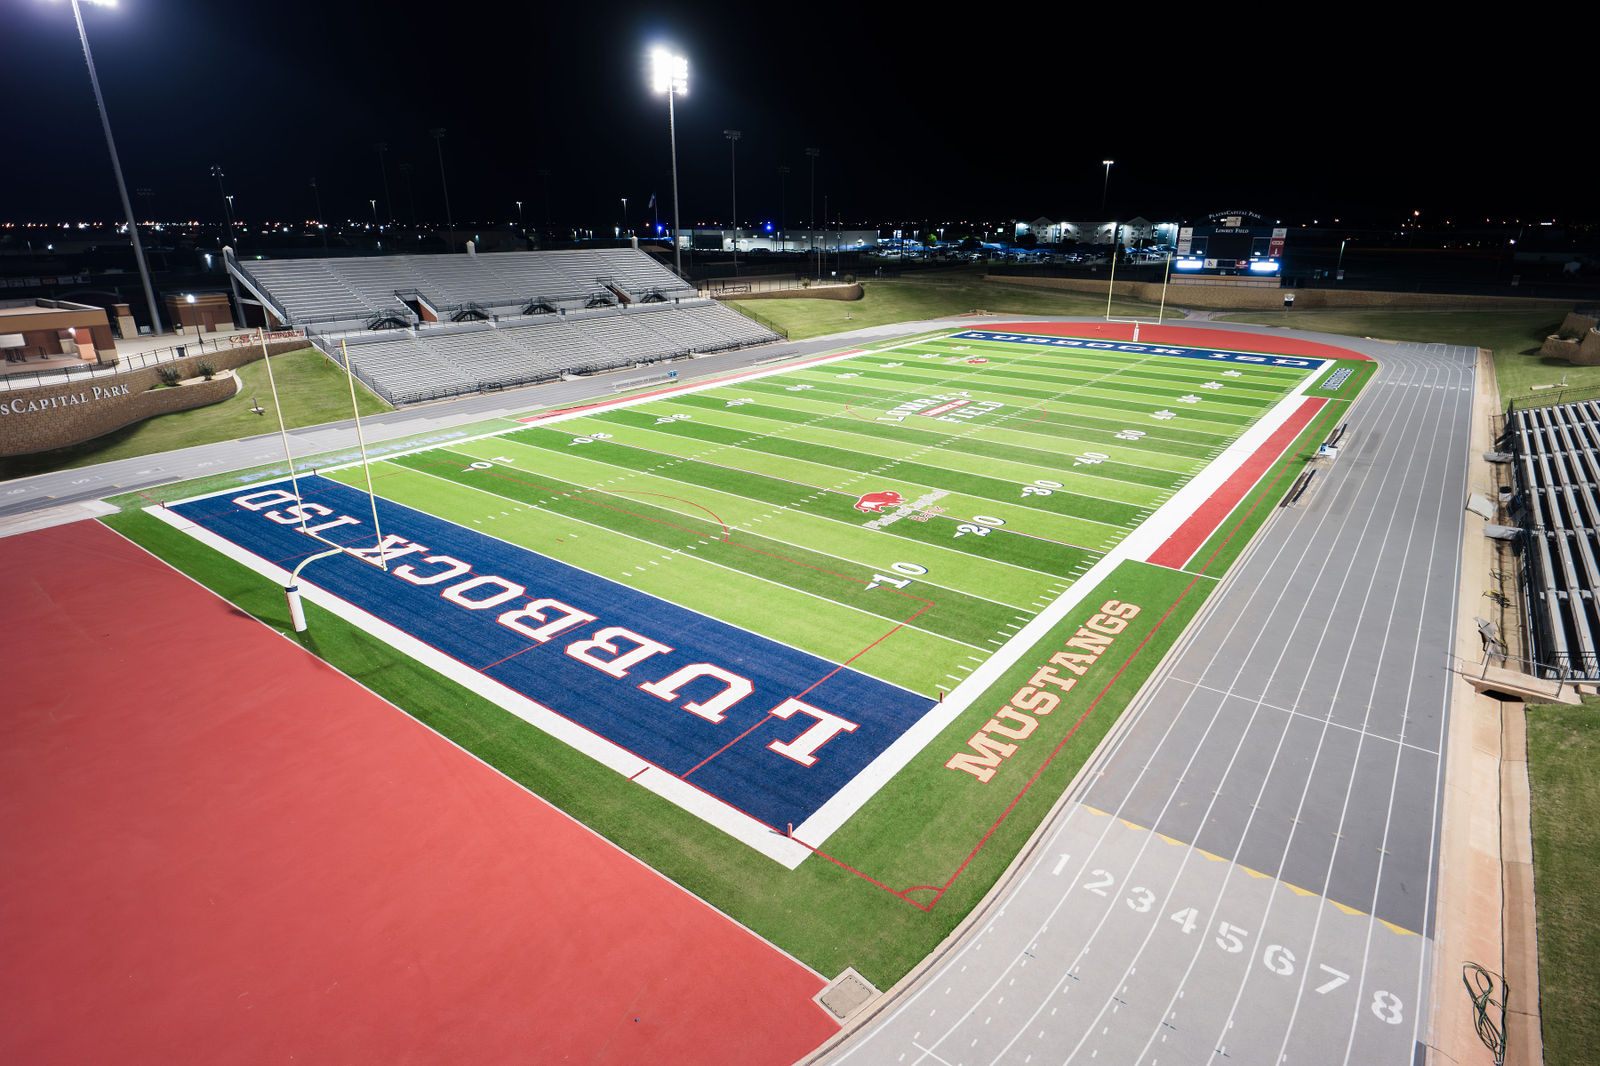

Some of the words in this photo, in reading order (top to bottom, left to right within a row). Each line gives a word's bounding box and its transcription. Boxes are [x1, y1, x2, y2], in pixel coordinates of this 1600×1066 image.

[1208, 353, 1310, 367] ISD
[92, 383, 130, 401] PARK
[875, 391, 973, 422] LOWREY
[934, 401, 1005, 423] FIELD
[1075, 451, 1111, 464] 40
[1022, 480, 1064, 496] 30
[232, 489, 363, 535] ISD
[957, 515, 1006, 537] 20
[872, 562, 928, 589] 10
[346, 534, 859, 767] LUBBOCK
[944, 599, 1142, 784] MUSTANGS
[1049, 853, 1072, 877] 1
[1083, 869, 1115, 897] 2
[1126, 886, 1156, 914] 3
[1170, 907, 1198, 934] 4
[1215, 921, 1248, 954] 5
[1262, 944, 1295, 976] 6
[1315, 963, 1350, 995] 7
[1371, 990, 1404, 1025] 8
